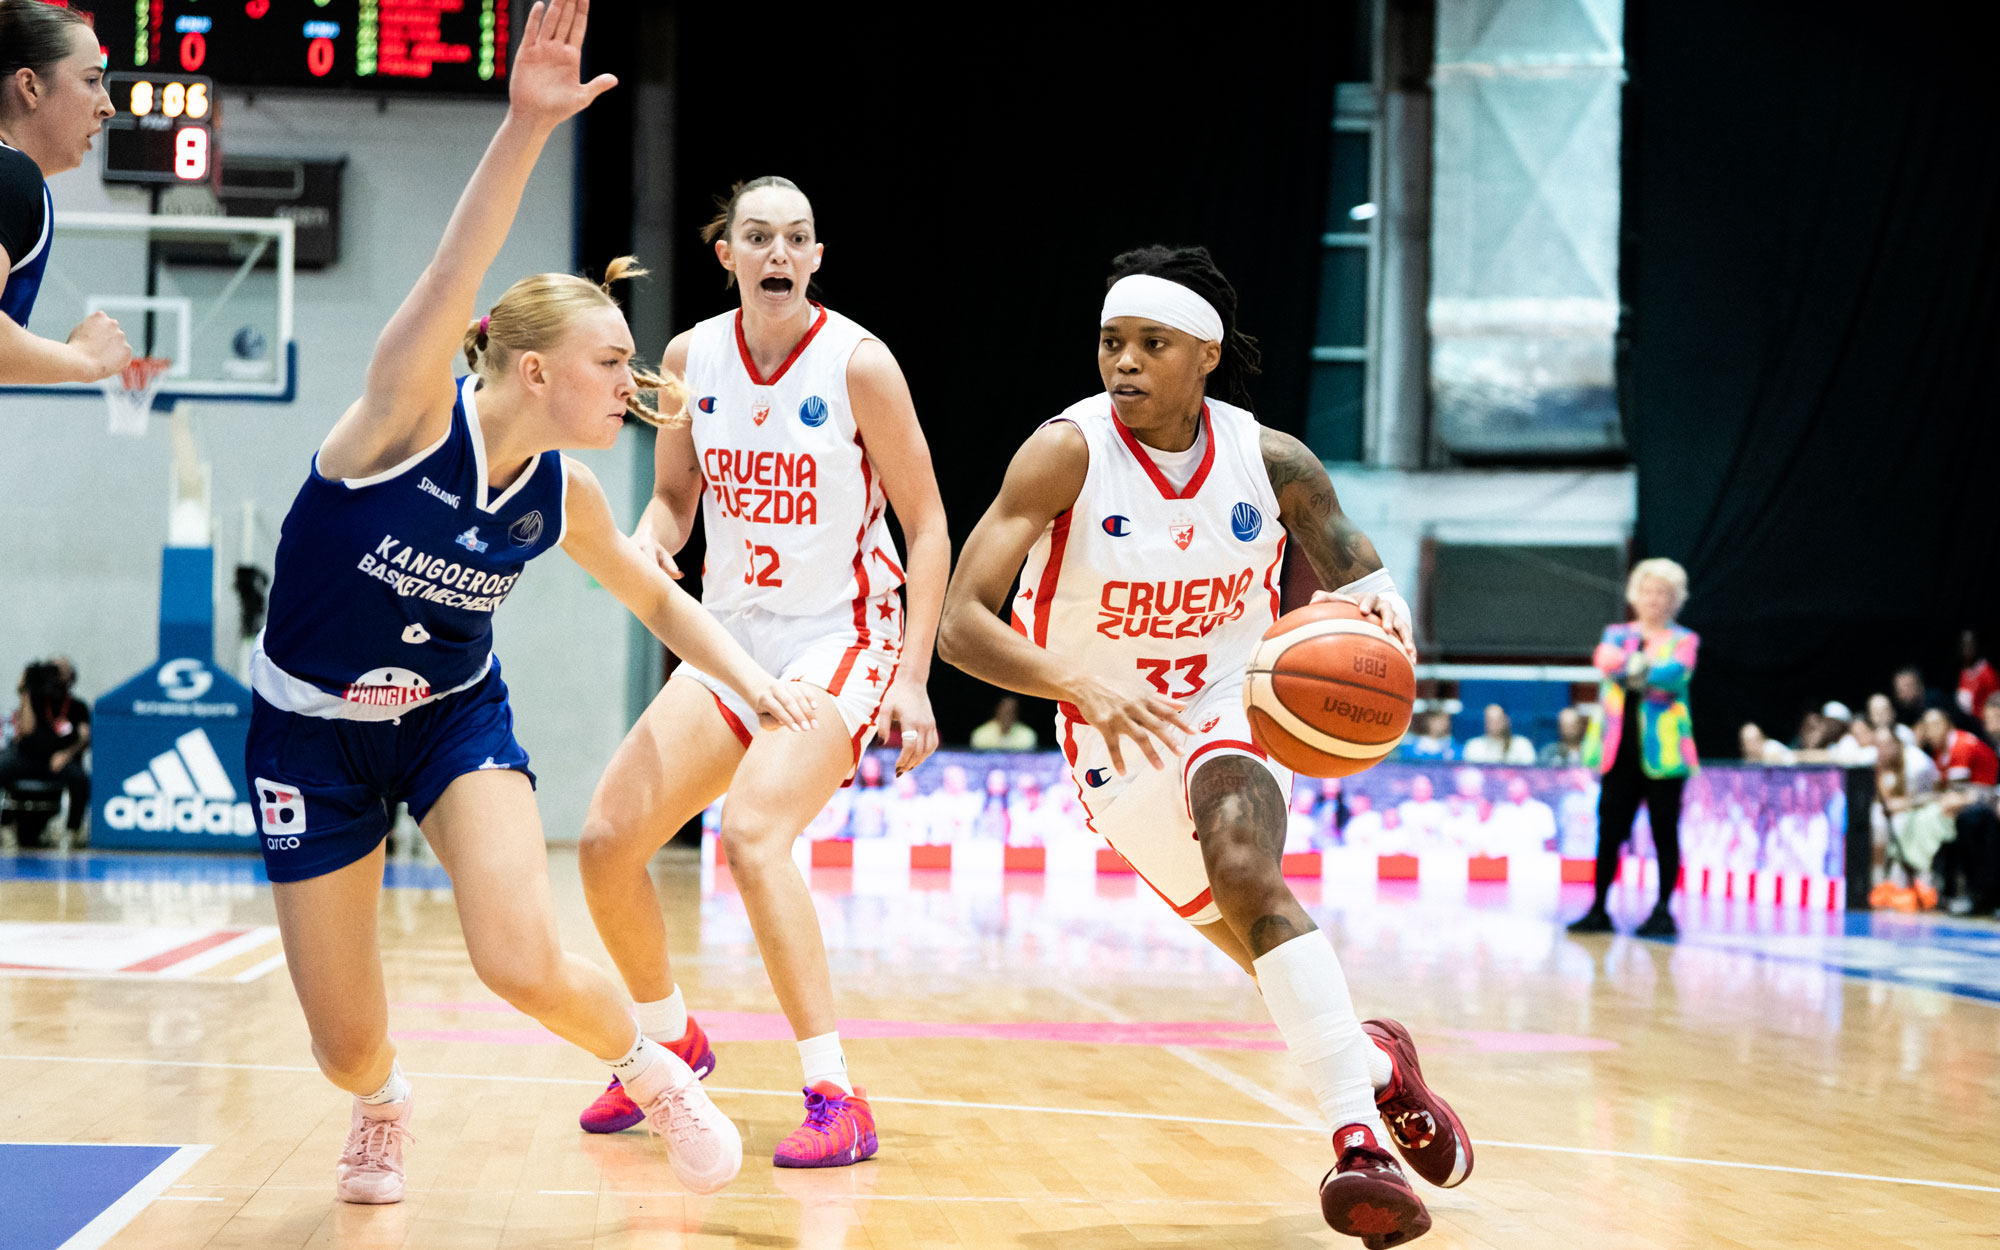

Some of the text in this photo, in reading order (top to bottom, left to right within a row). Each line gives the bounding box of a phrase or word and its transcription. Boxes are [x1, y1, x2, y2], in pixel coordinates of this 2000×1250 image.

[180, 32, 206, 72] 0
[308, 37, 335, 77] 0
[175, 126, 208, 180] 8
[416, 476, 461, 510] SPALDING
[374, 534, 519, 595] KANGOEROES
[1136, 654, 1208, 699] 33
[1323, 696, 1393, 726] molten
[103, 795, 258, 837] adidas
[267, 836, 301, 851] arco
